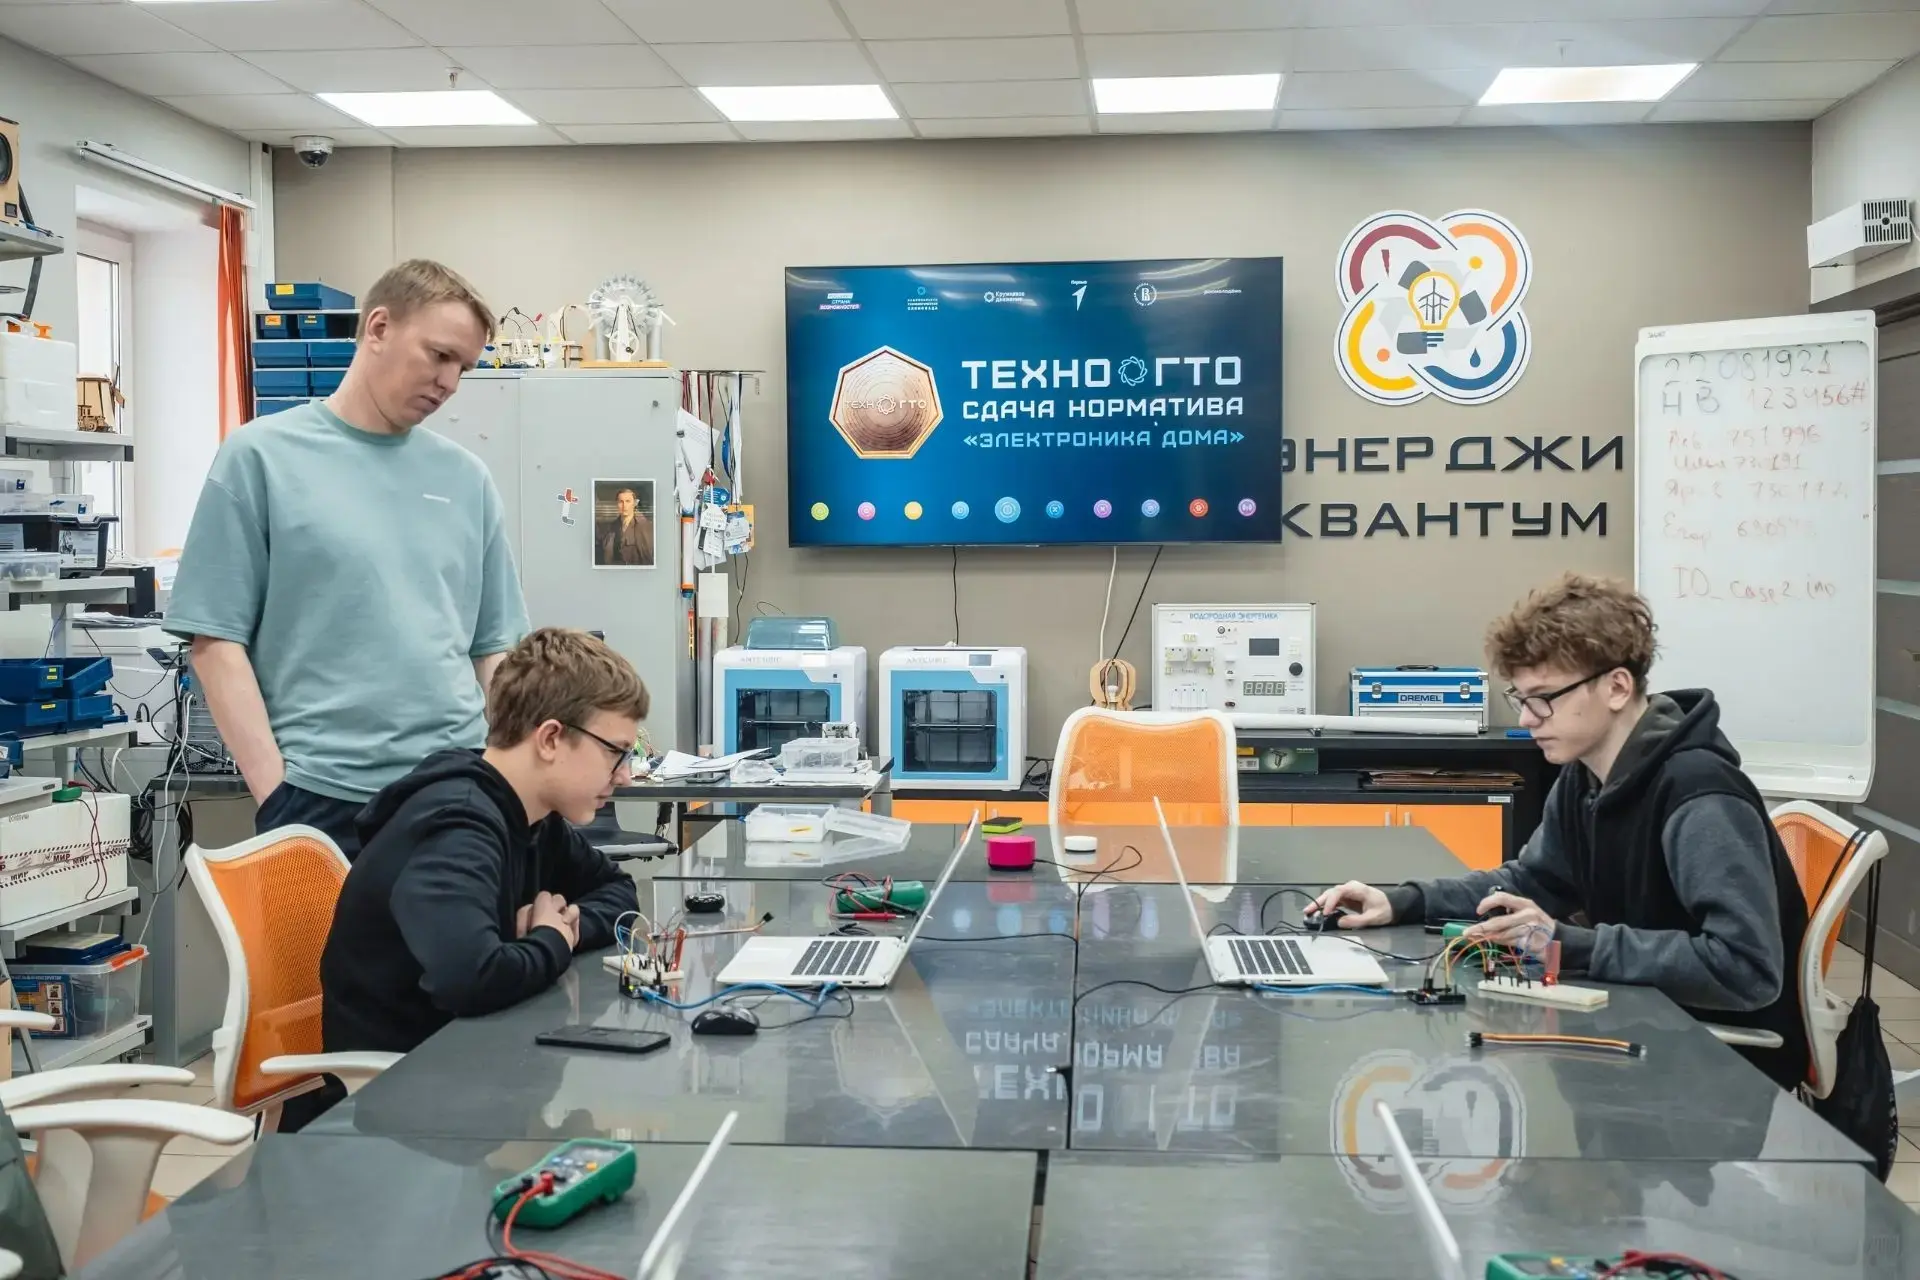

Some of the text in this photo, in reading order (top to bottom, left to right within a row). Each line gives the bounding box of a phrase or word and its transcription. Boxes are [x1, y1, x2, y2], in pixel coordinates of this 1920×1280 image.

[961, 355, 1242, 390] ТЕХНО ГТО
[962, 396, 1244, 422] СДАЧА НОРМАТИВА
[962, 429, 1245, 448] «ЭЛЕКТРОНИКА ДОМА»
